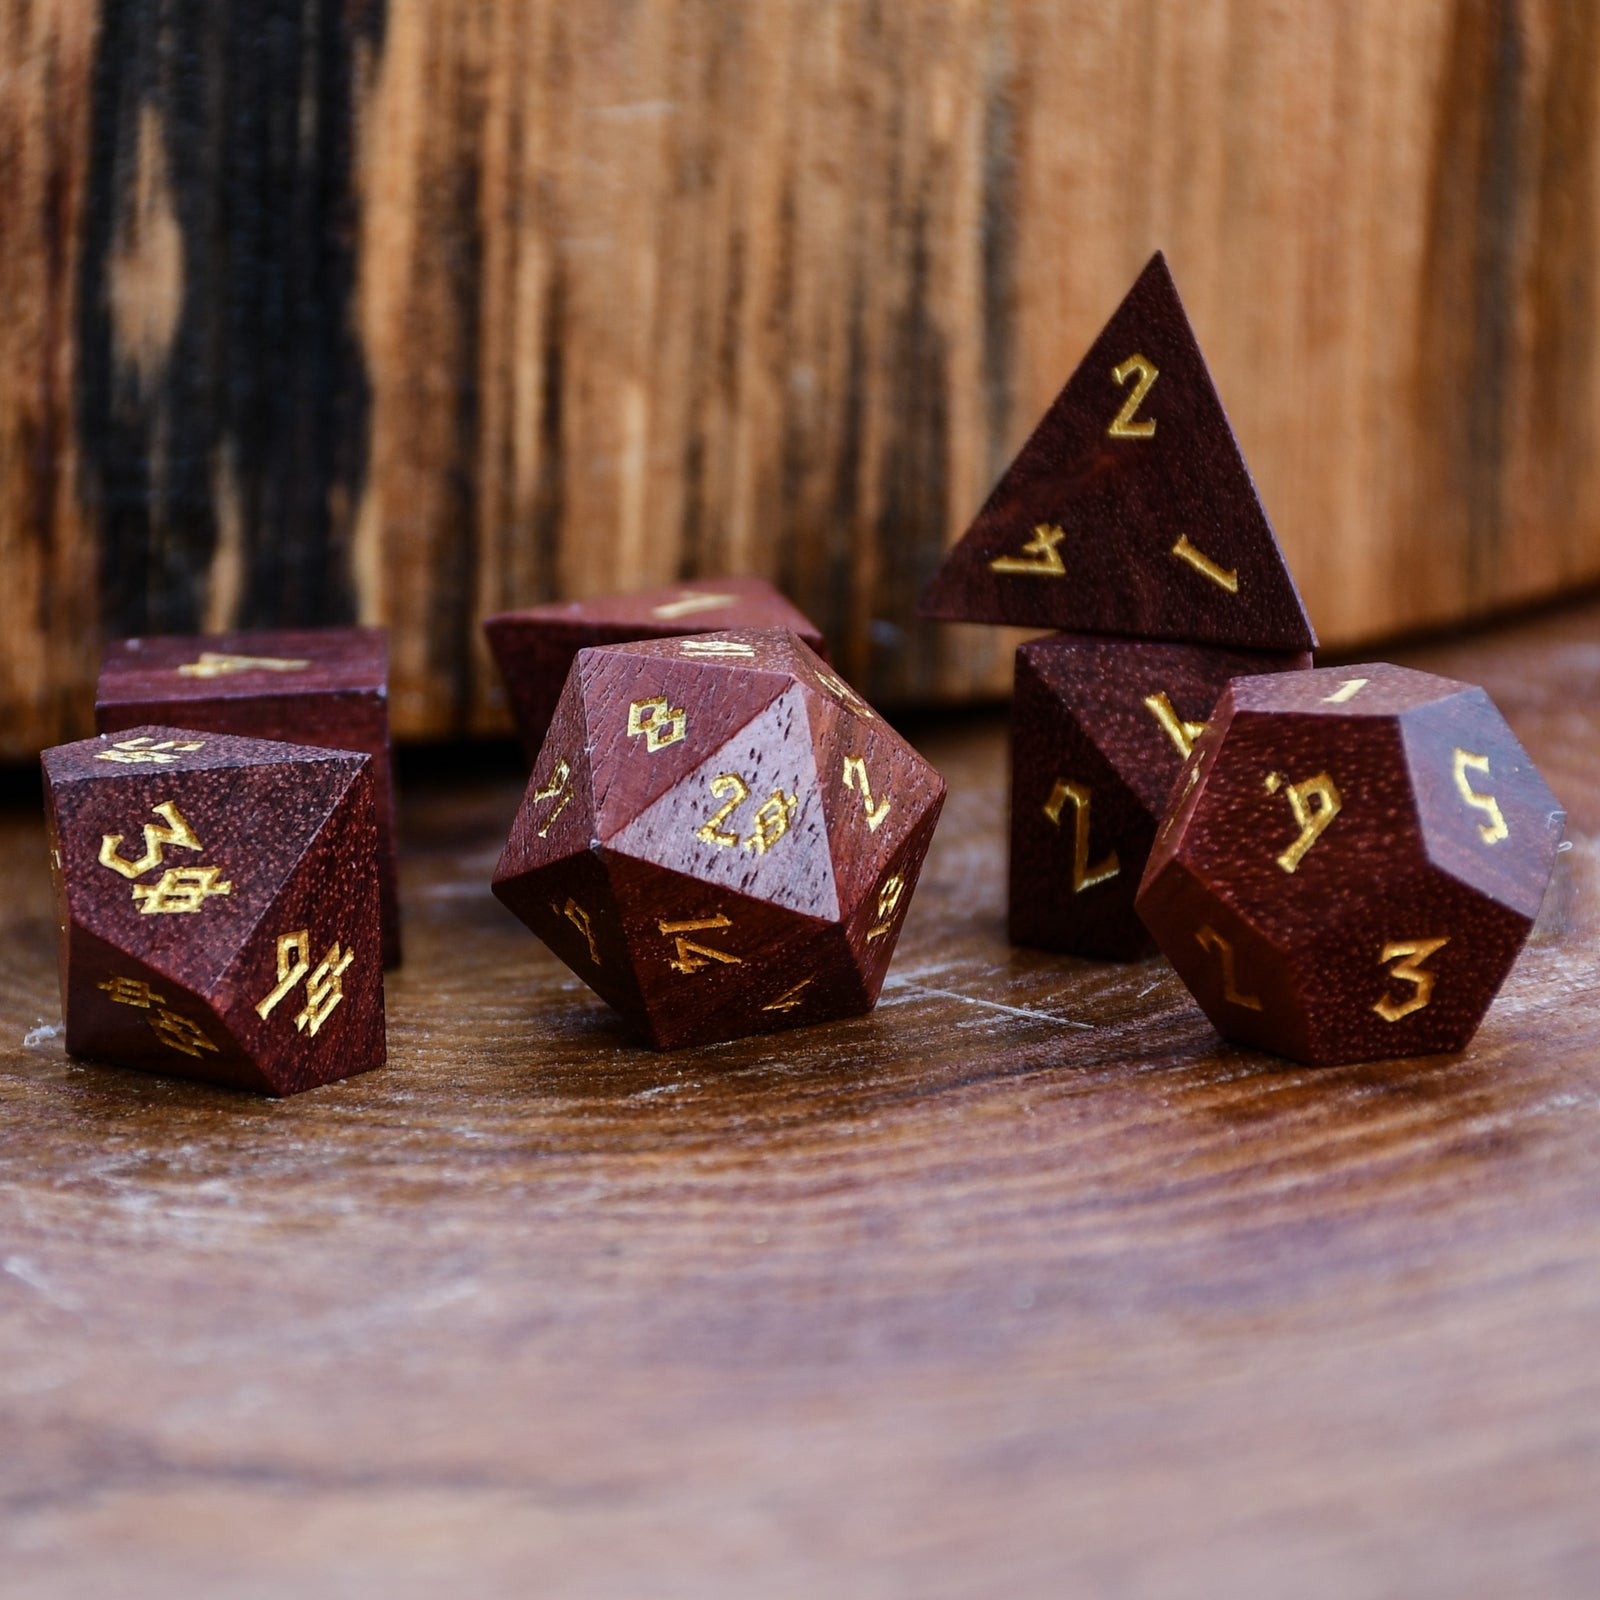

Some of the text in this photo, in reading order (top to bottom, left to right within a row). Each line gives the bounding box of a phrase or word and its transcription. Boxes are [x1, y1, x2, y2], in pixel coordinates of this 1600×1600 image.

[1109, 353, 1159, 439] 2
[990, 523, 1066, 576] 4
[1172, 533, 1239, 594] 1
[627, 696, 686, 753] 8
[1323, 678, 1369, 702] 1
[697, 773, 799, 855] 20
[843, 755, 891, 833] 2
[1453, 747, 1508, 844] 5
[98, 800, 232, 914] 30
[1043, 778, 1120, 893] 2
[658, 913, 743, 974] 14
[1372, 936, 1451, 1023] 3
